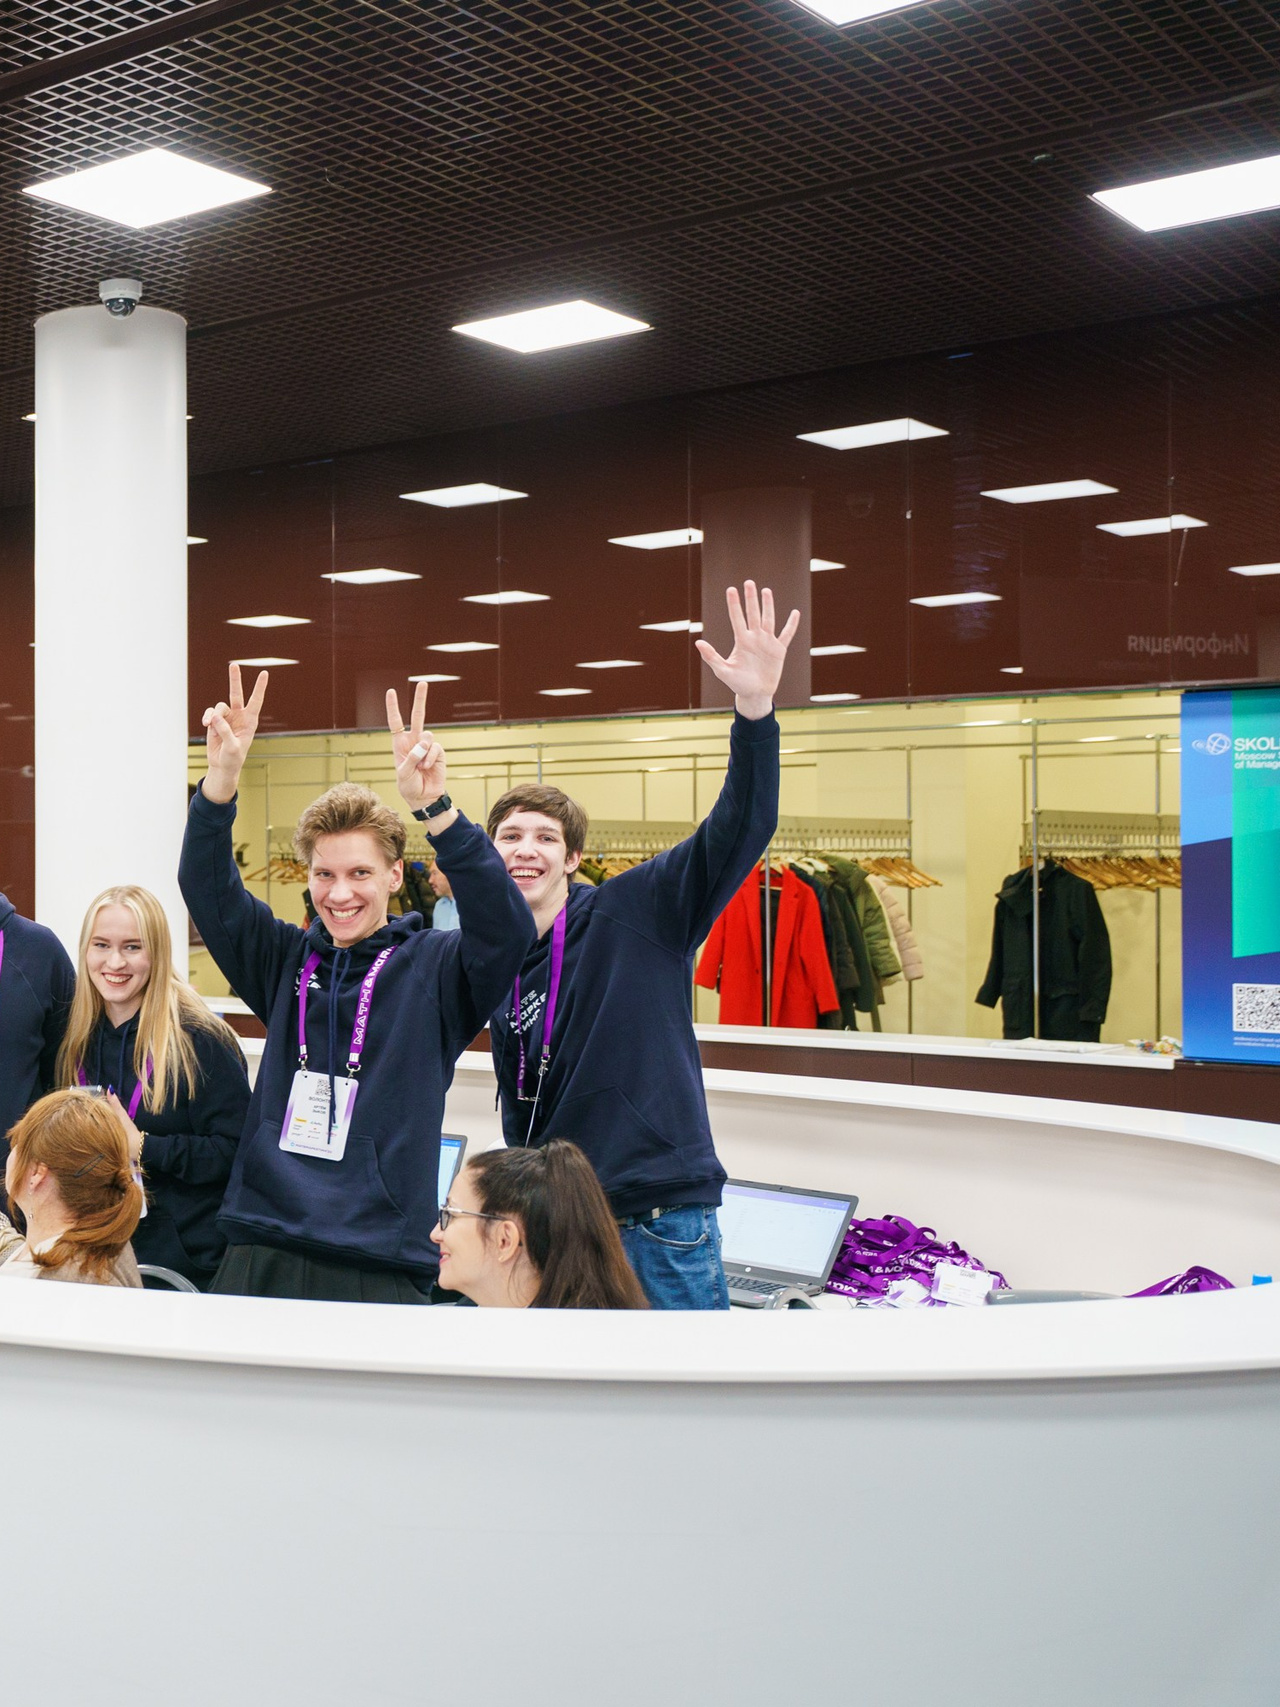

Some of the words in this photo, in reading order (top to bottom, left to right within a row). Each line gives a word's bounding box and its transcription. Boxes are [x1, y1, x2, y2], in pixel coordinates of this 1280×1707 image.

[1234, 736, 1280, 751] SKOL
[1234, 752, 1276, 761] Moscow
[1246, 760, 1280, 770] Manag
